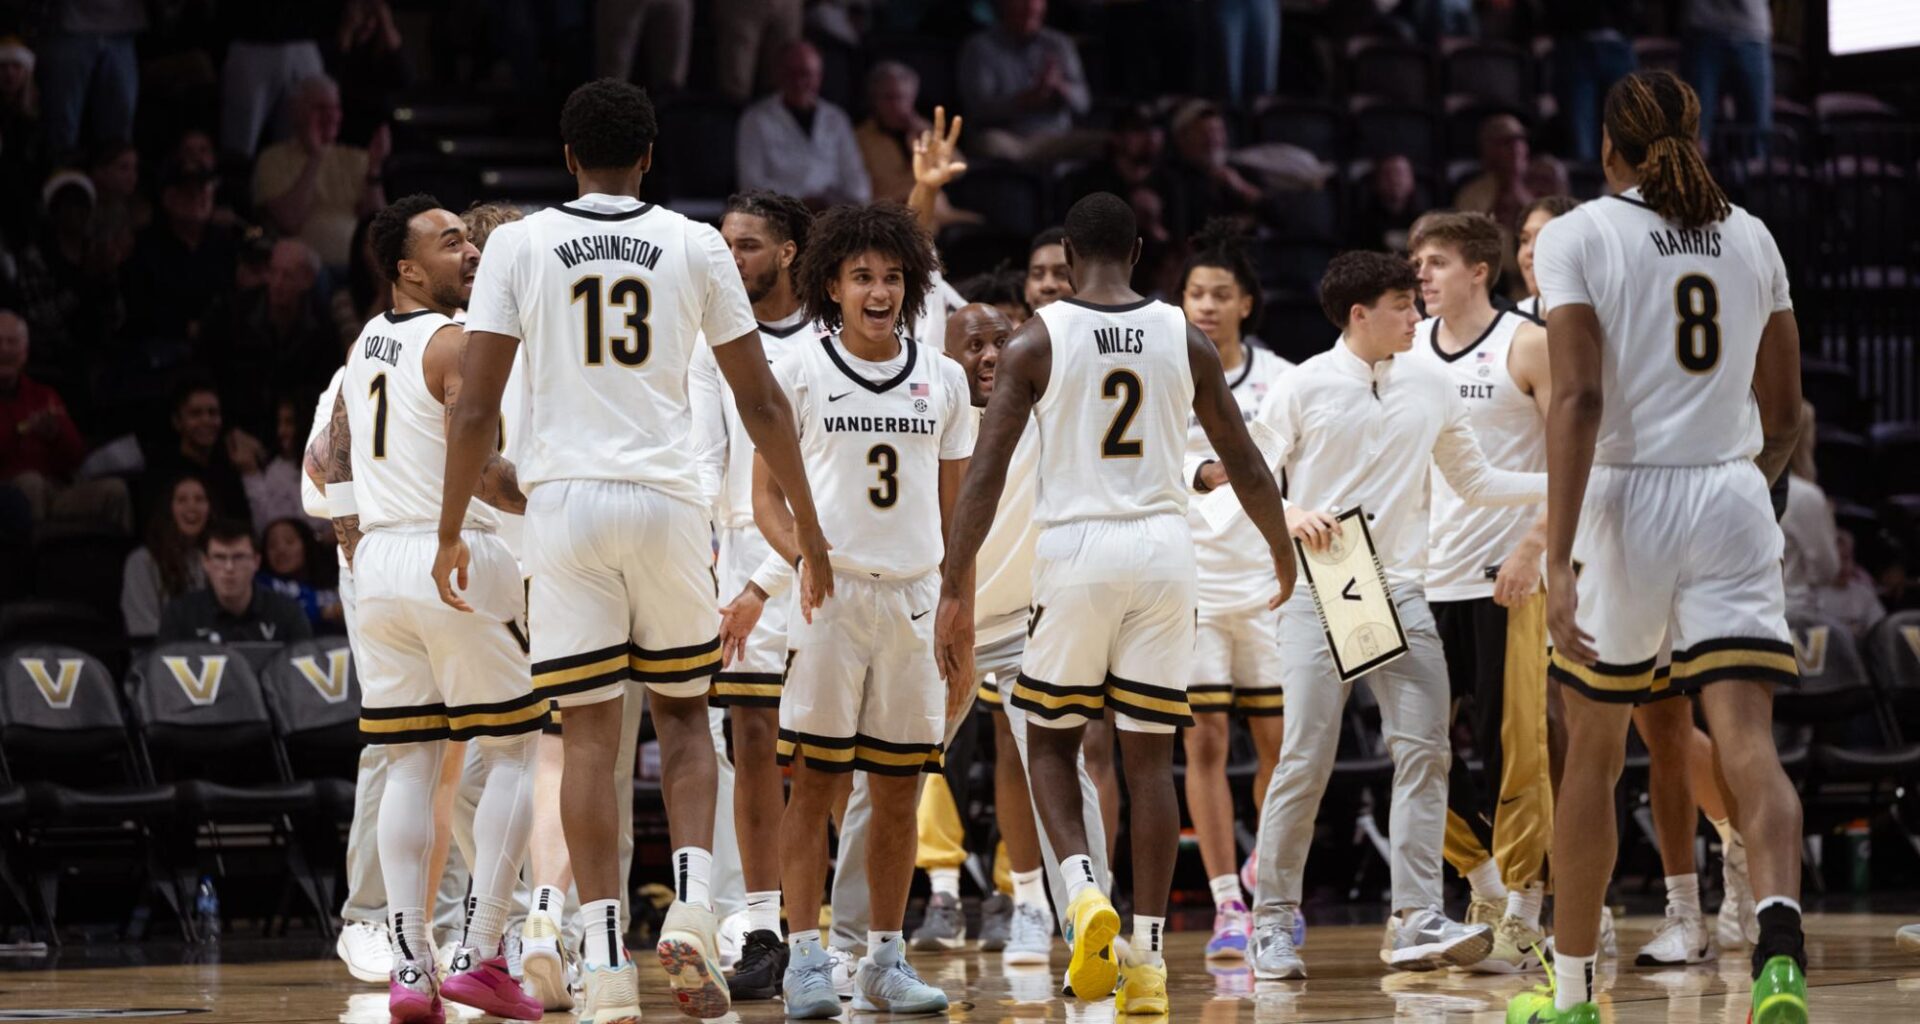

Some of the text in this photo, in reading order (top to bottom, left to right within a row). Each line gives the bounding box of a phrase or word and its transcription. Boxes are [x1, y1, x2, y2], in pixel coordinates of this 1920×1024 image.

[553, 235, 663, 271] WASHINGTON
[1650, 228, 1722, 258] HARRIS
[570, 274, 653, 368] 13
[1093, 327, 1144, 355] MILES
[1674, 272, 1722, 376] 8
[365, 335, 402, 367] COLLINS
[369, 371, 388, 460] 1
[1101, 368, 1143, 459] 2
[1456, 384, 1495, 399] BILT
[823, 416, 936, 435] VANDERBILT
[867, 443, 899, 510] 3
[19, 658, 84, 709] V
[161, 655, 228, 706] V
[290, 647, 349, 704] V
